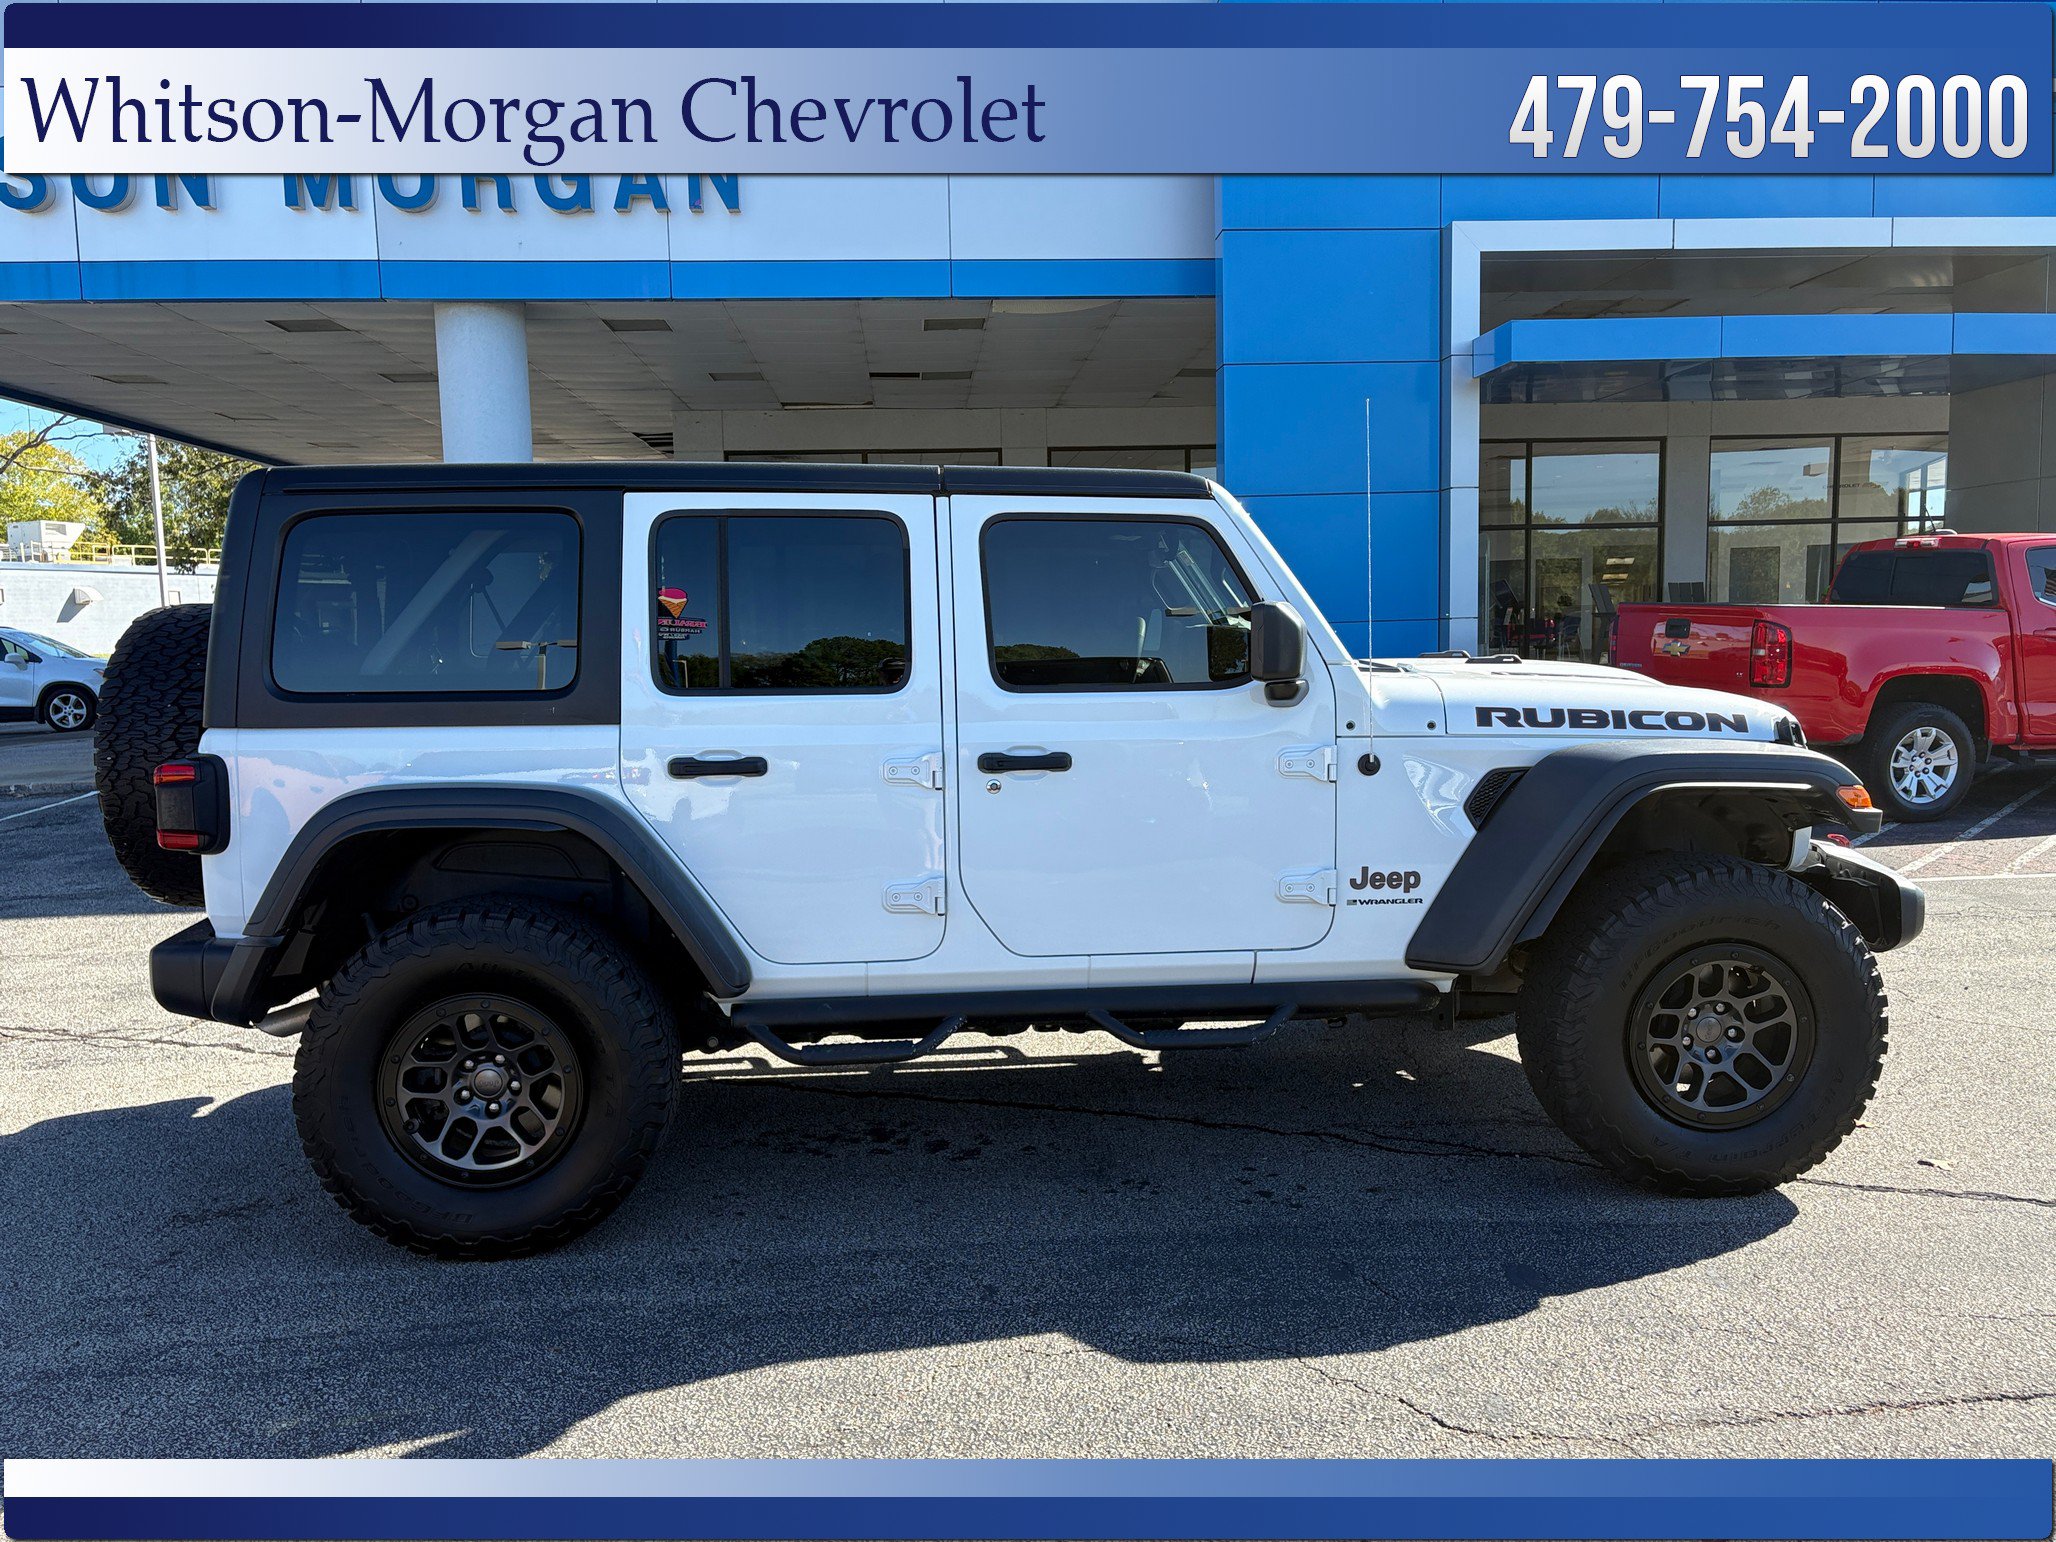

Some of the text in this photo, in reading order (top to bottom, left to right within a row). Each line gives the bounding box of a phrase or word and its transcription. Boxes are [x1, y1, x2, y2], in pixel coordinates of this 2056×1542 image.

[1475, 706, 1750, 733] RUBICON
[1349, 866, 1421, 894] Jeep
[1358, 898, 1424, 906] WRANGLER
